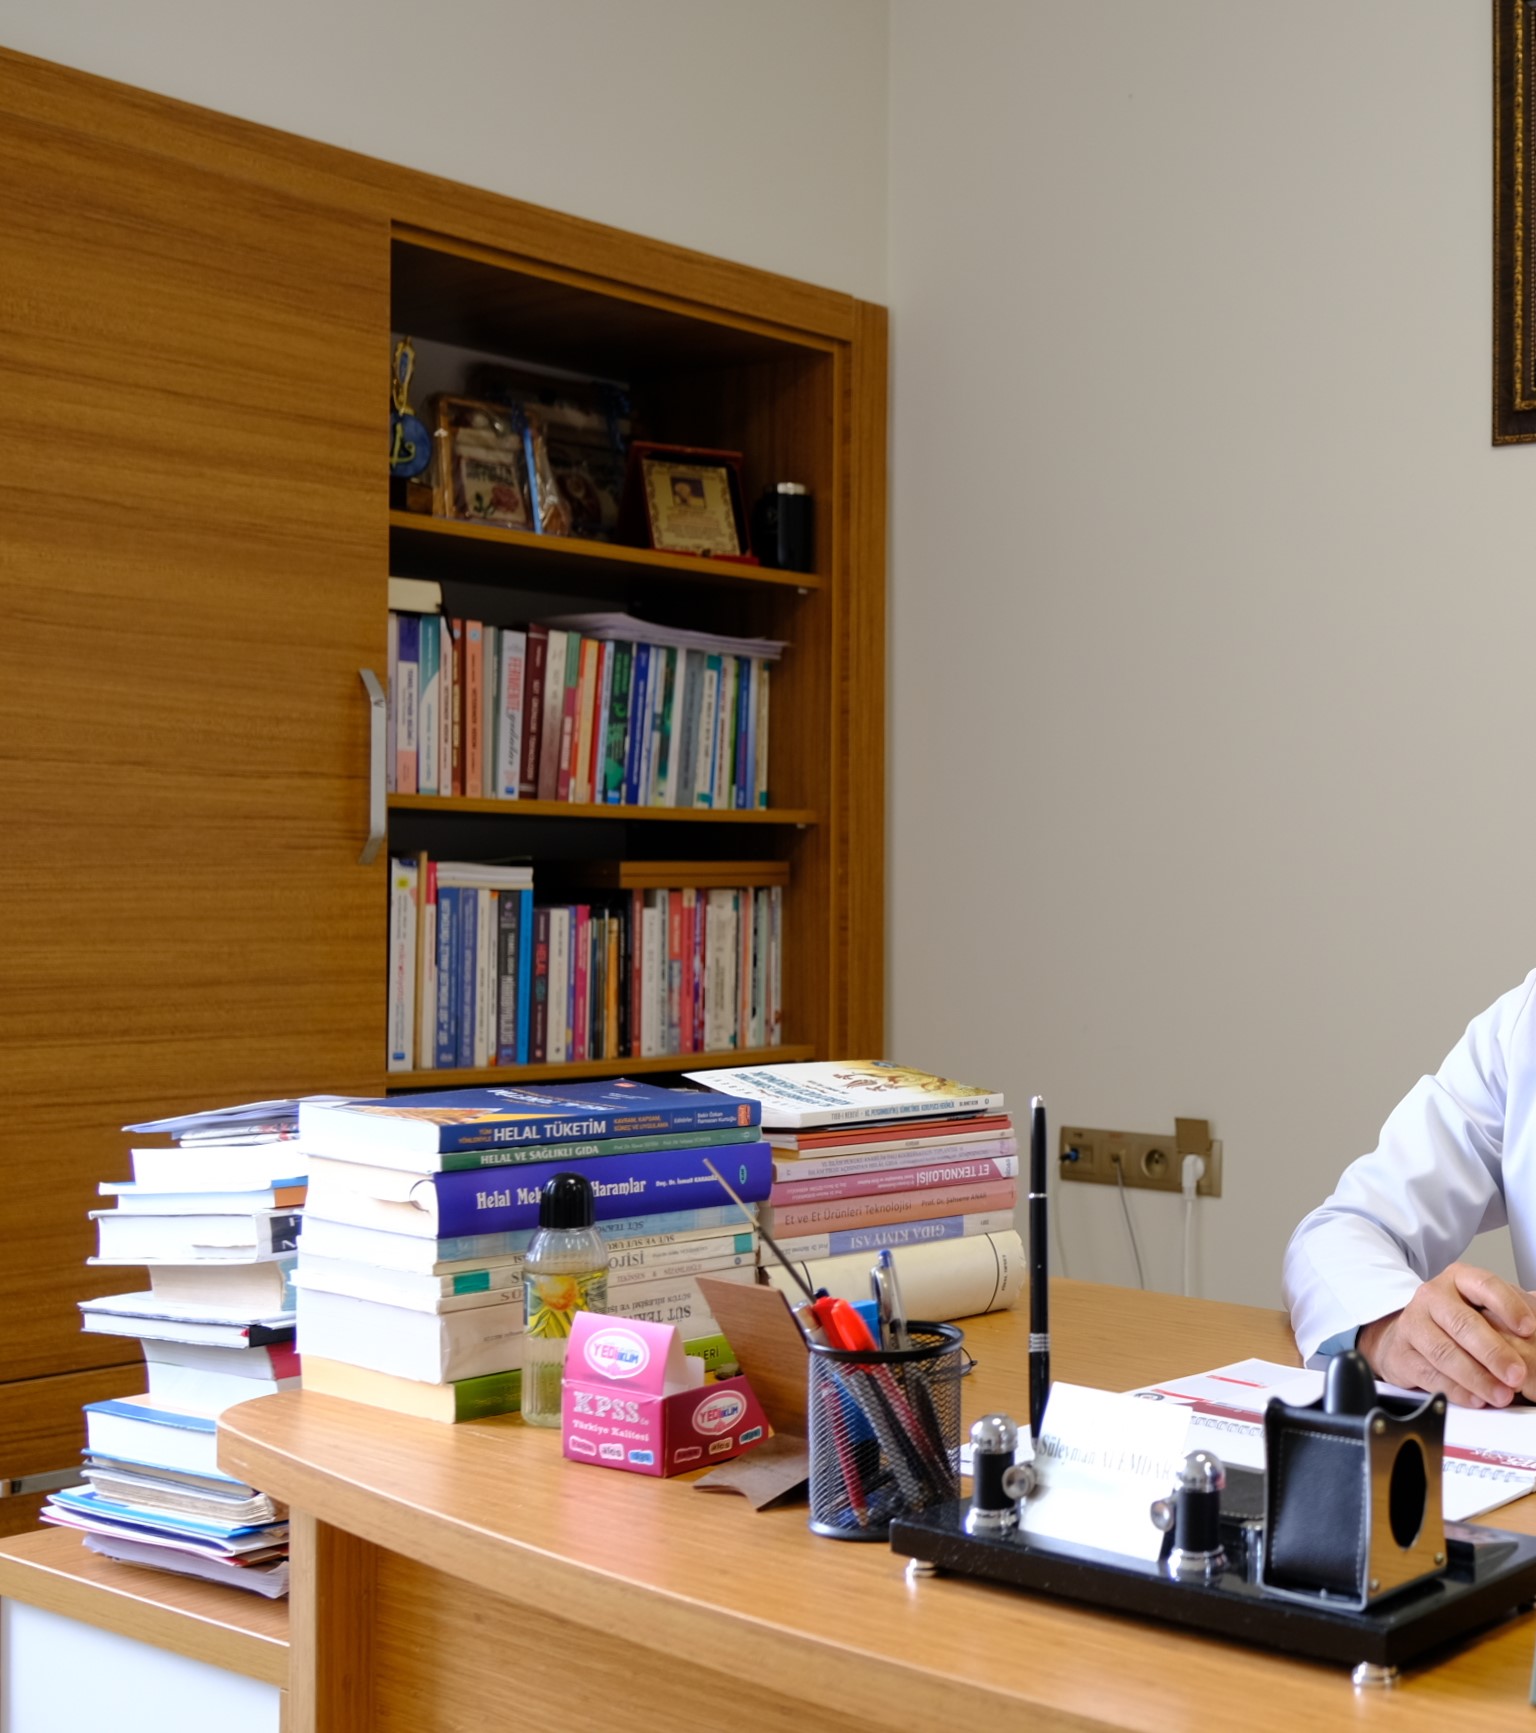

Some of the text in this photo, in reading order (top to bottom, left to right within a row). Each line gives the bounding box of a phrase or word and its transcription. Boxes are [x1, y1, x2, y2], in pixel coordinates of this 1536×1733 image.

[494, 1118, 606, 1142] HELAL TÜKETİM
[480, 1145, 600, 1165] HELAL VE SAĞLIKLI GIDA
[916, 1166, 978, 1187] TEKNOLOJİSİ
[979, 1164, 990, 1176] ET
[477, 1190, 511, 1210] Helal
[784, 1201, 912, 1226] Et ve Et Ürünleri Teknolojisi
[850, 1223, 945, 1249] GIDA KİMYASI
[667, 1305, 692, 1322] SÜT
[573, 1391, 641, 1424] KPSS
[572, 1419, 649, 1442] Türkiye Kalitesi
[1038, 1433, 1096, 1466] Süleyman
